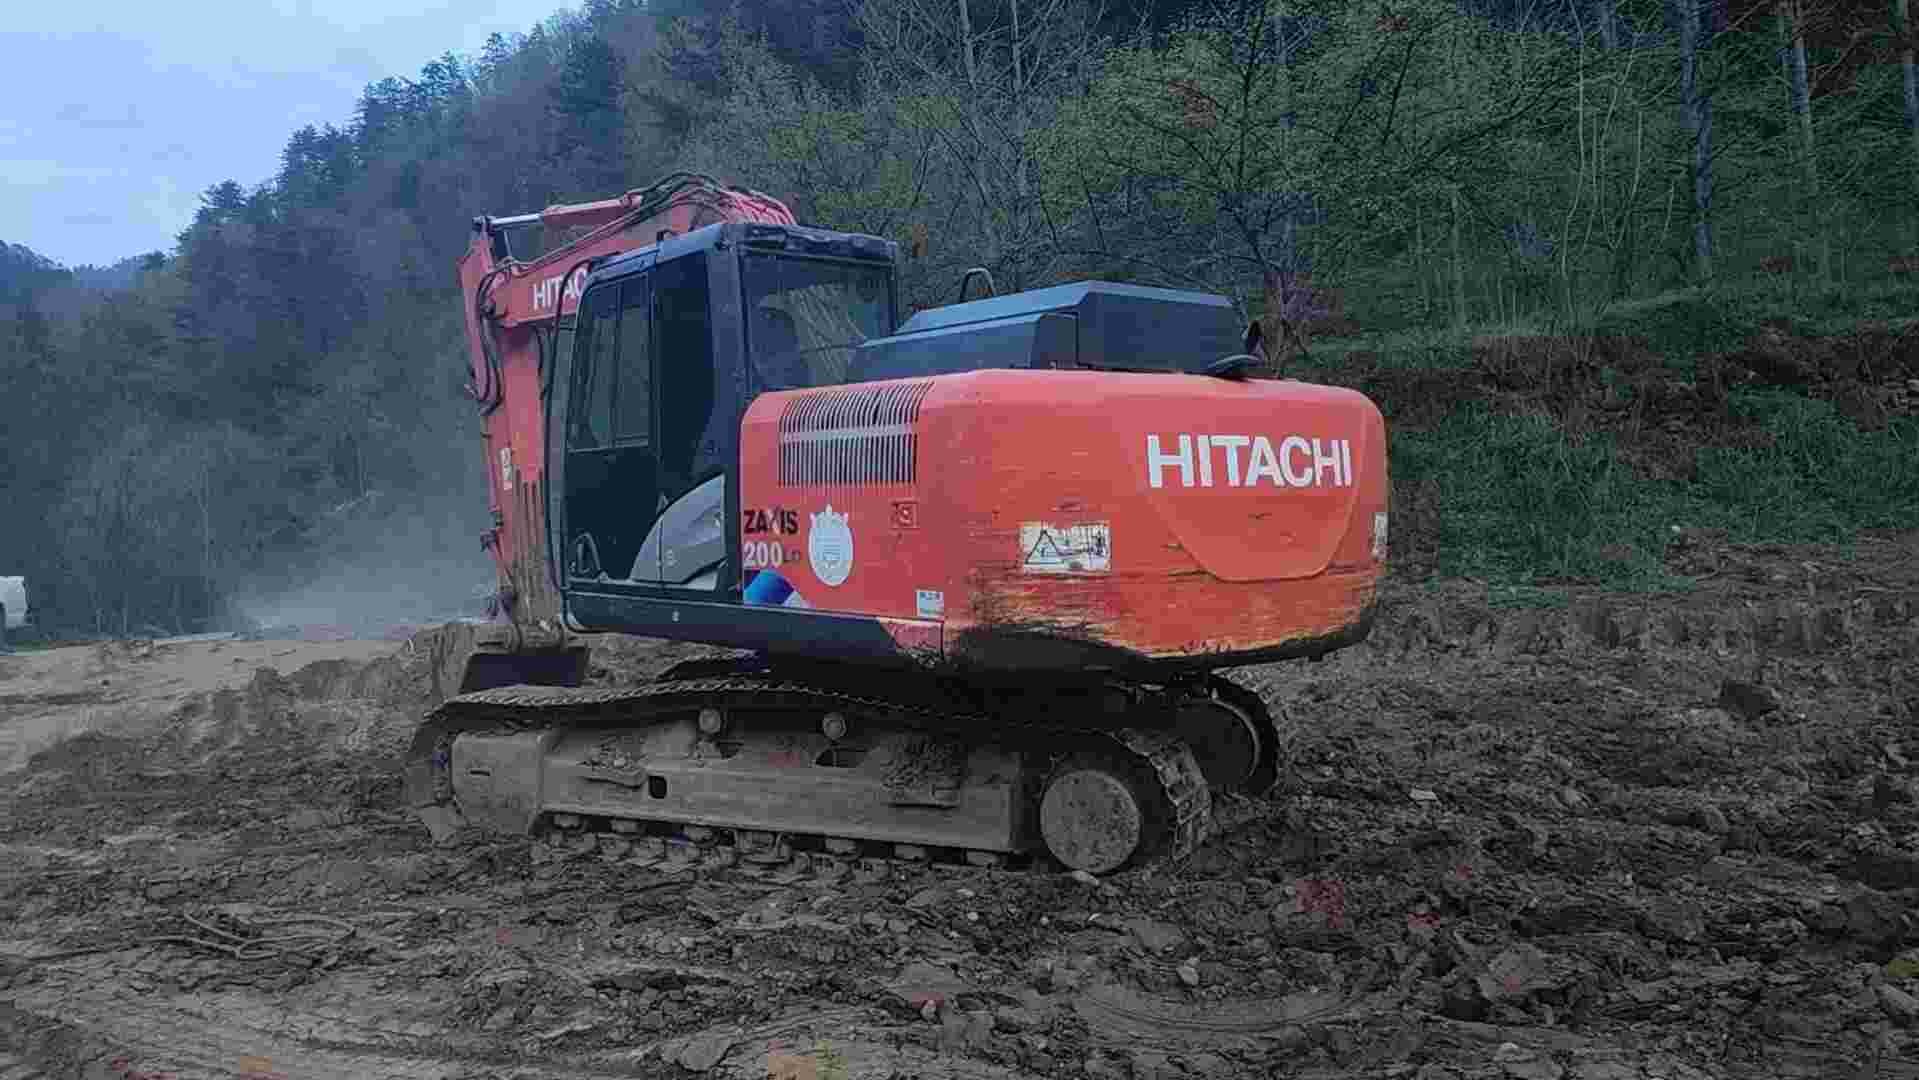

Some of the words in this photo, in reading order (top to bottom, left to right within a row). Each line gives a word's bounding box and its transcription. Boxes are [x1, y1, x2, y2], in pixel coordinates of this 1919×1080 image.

[1147, 434, 1353, 488] HITACHI
[743, 509, 800, 534] ZAXIS
[743, 541, 784, 568] 200
